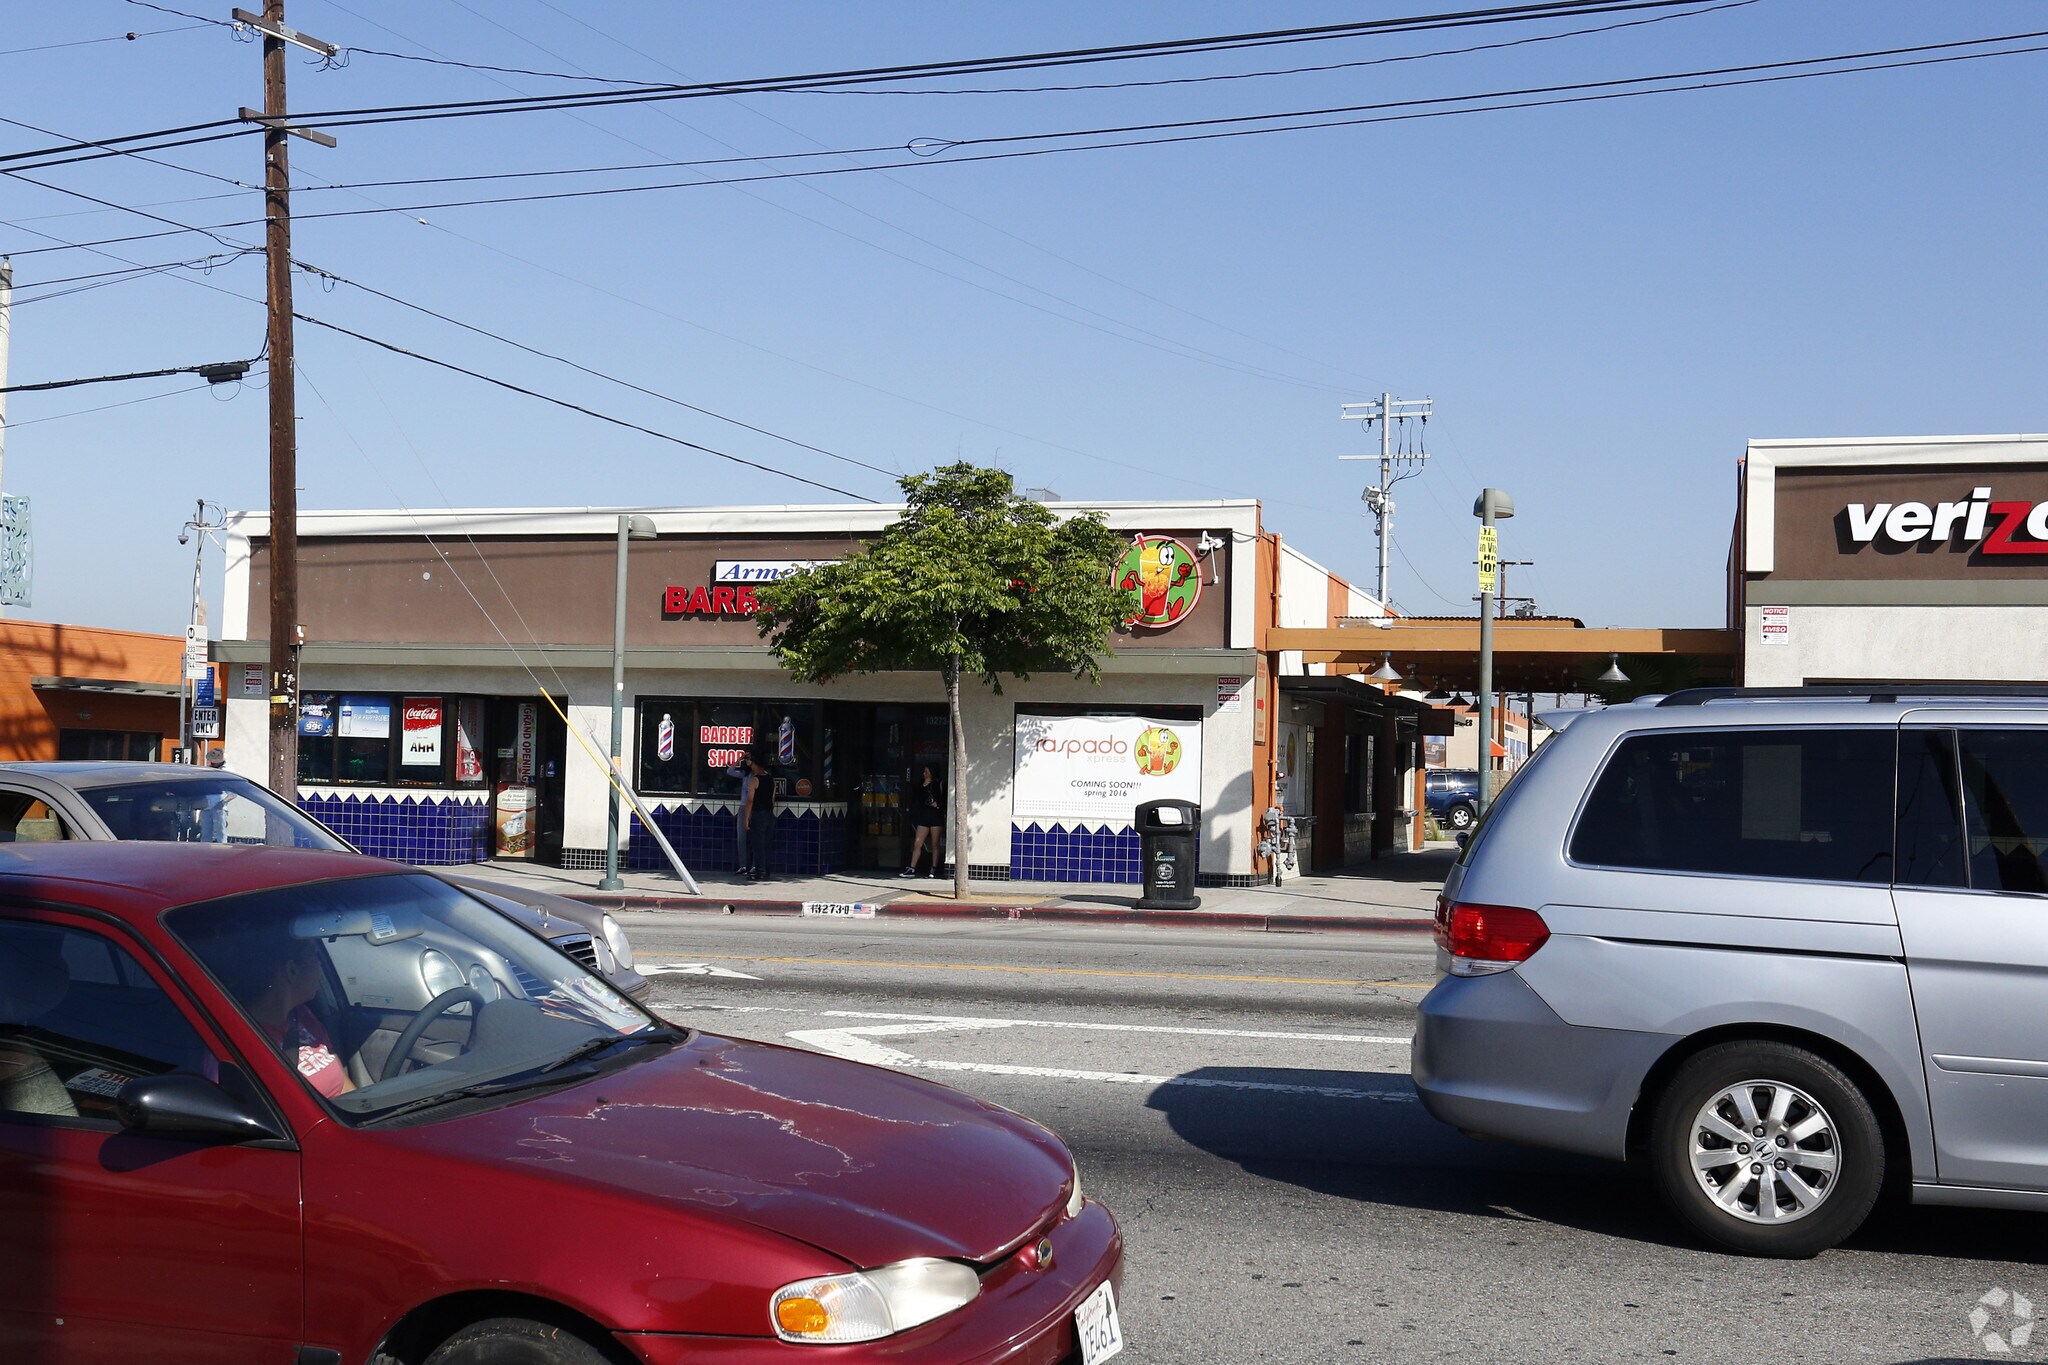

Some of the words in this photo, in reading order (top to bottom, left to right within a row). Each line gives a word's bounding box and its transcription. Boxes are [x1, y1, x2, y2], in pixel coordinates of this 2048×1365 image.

[665, 586, 774, 613] BARB
[194, 710, 217, 721] ENTER
[523, 708, 532, 739] GRAND
[195, 722, 214, 734] ONLY
[700, 725, 754, 745] BARBER
[1036, 734, 1128, 760] raspado
[521, 742, 531, 784] OPENING
[707, 748, 745, 768] SHOP
[1087, 755, 1127, 764] xpress
[1070, 779, 1107, 788] COMING
[1108, 780, 1142, 789] SOON!!!
[1084, 789, 1107, 798] spring
[1109, 789, 1128, 797] 2016
